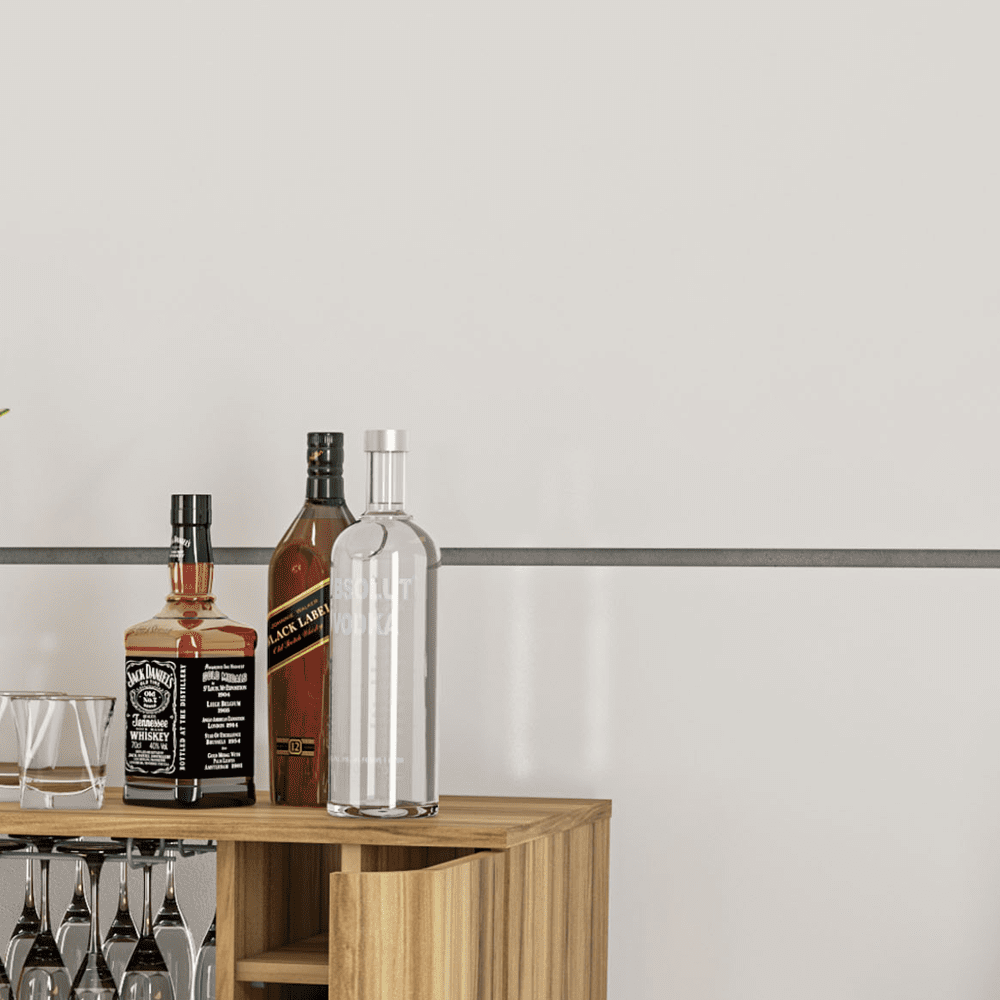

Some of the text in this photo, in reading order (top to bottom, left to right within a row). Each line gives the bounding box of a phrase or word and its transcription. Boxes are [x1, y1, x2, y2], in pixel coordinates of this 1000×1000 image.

[127, 668, 146, 688] JACK
[131, 713, 169, 728] Tennessee
[130, 731, 170, 742] WHISKEY
[179, 726, 187, 736] AT
[291, 742, 300, 751] 12
